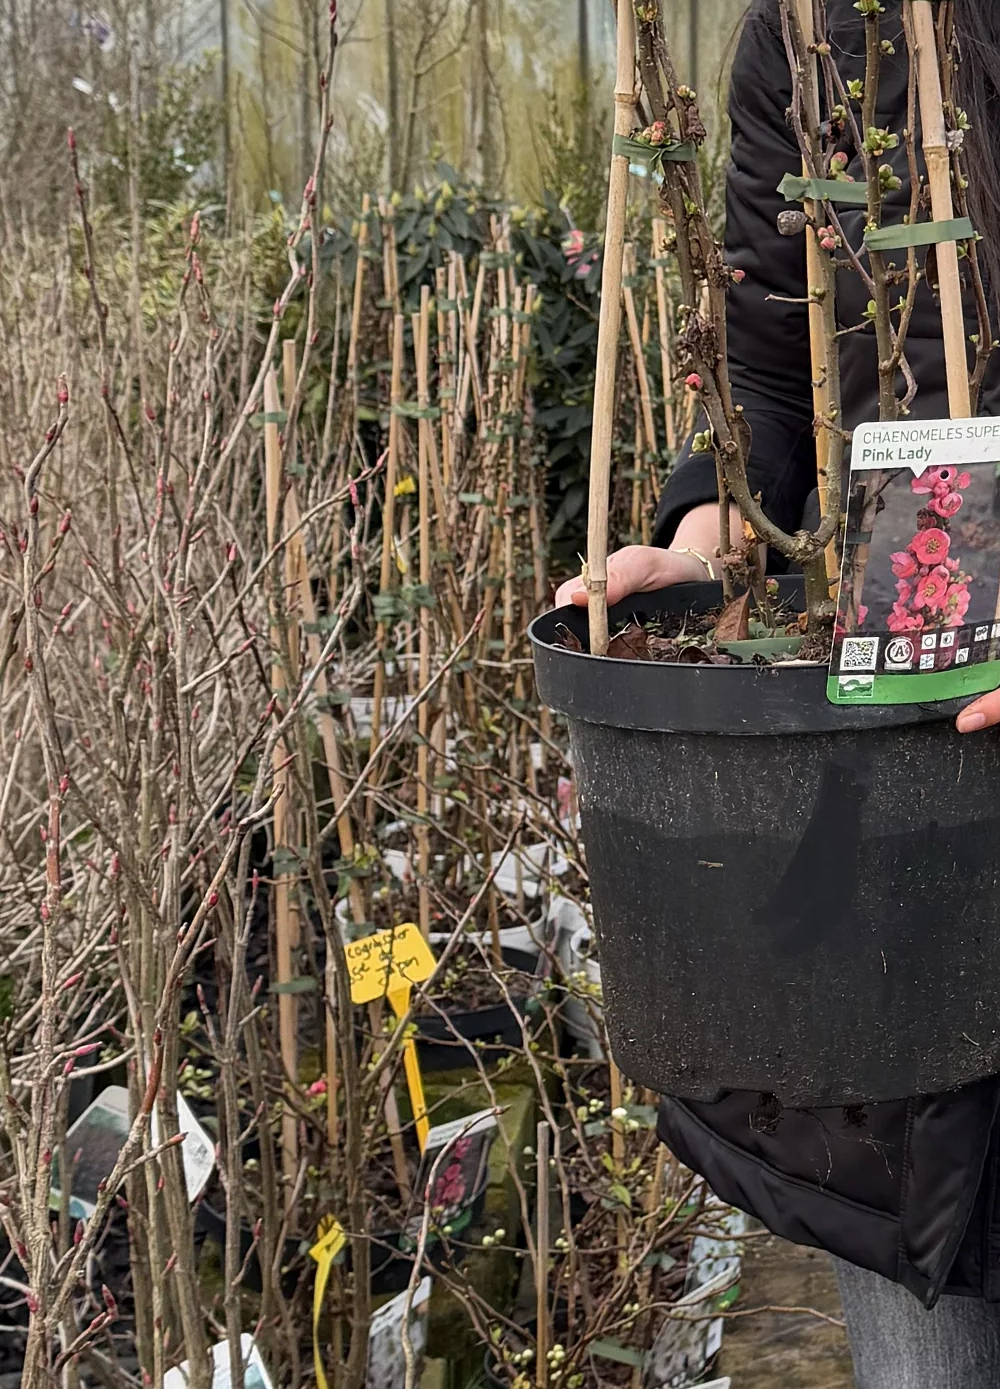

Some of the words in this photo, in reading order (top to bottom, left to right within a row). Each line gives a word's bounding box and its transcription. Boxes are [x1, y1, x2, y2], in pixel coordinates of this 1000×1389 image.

[863, 427, 963, 445] CHAENOMELES
[862, 448, 894, 462] Pink
[898, 447, 932, 462] Lady
